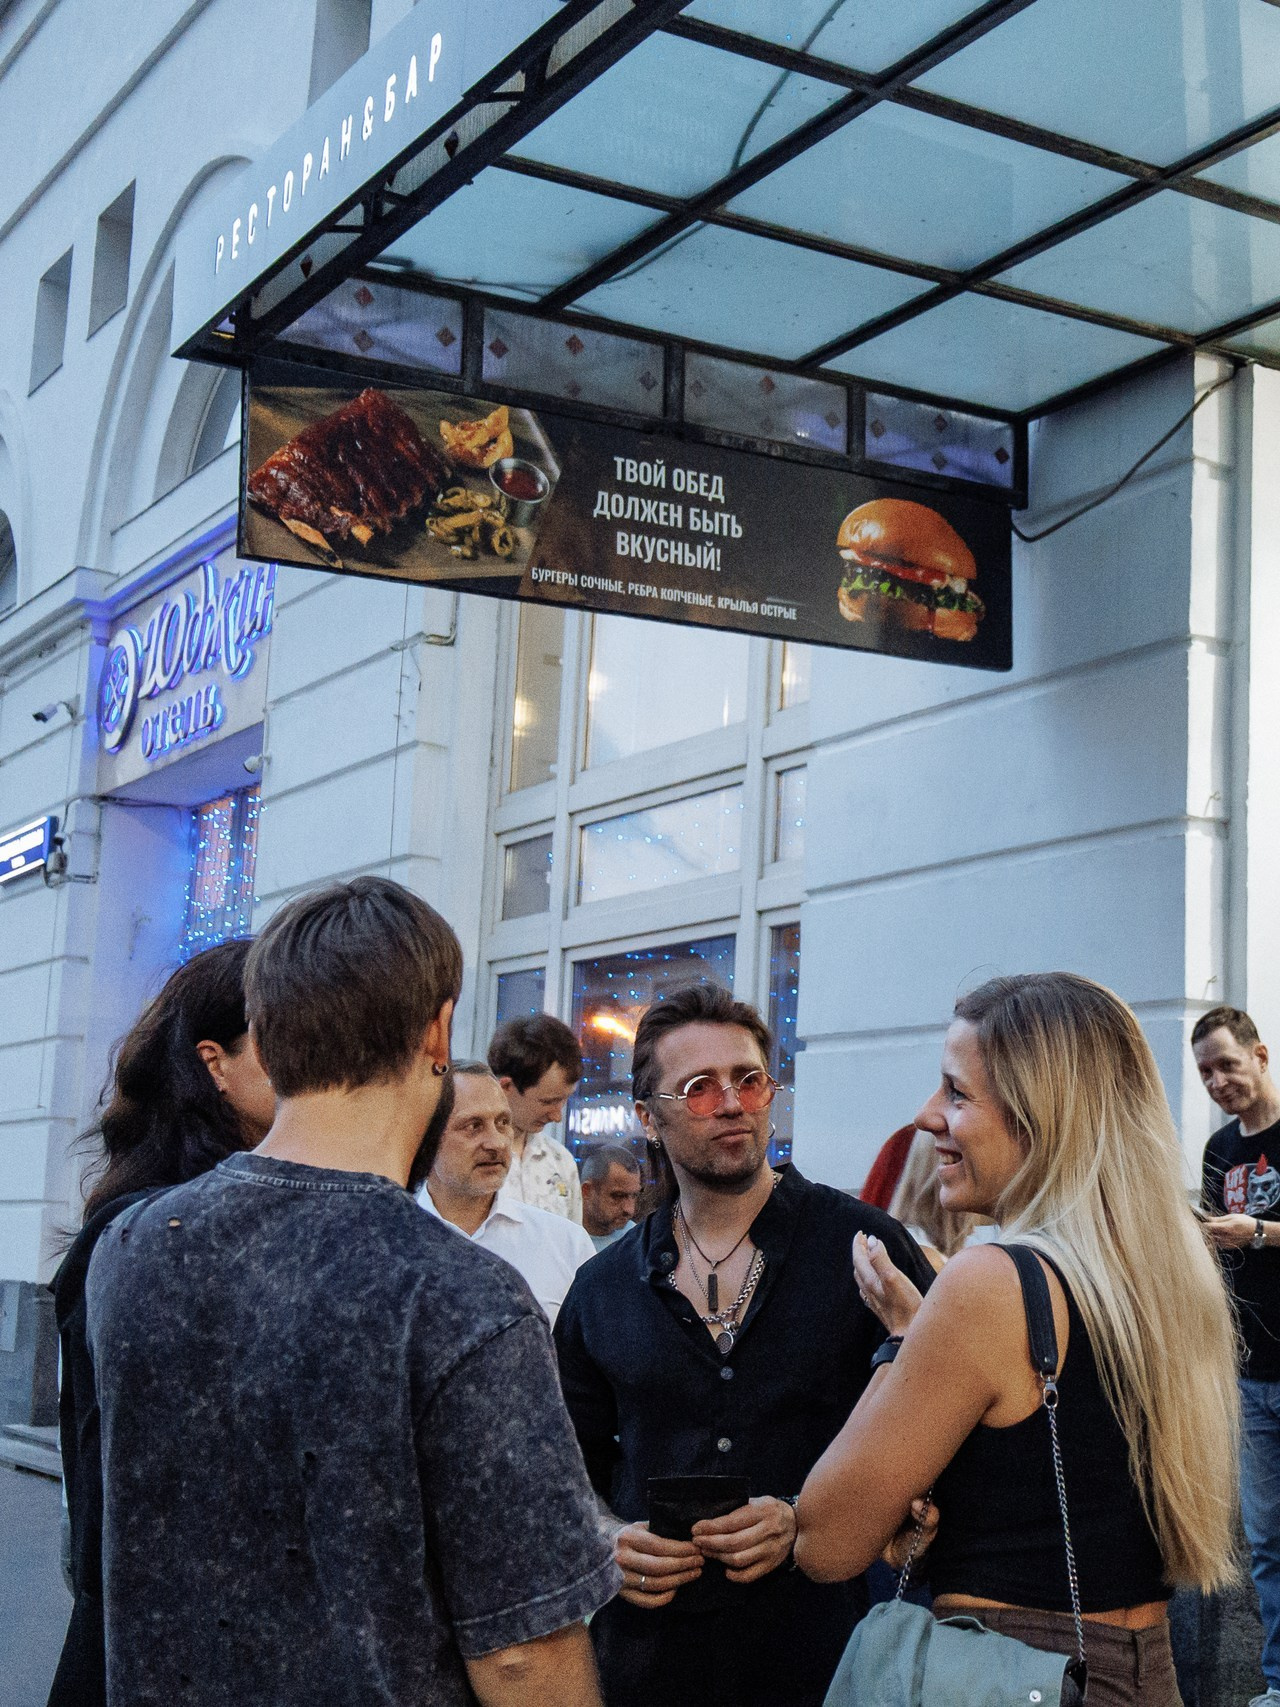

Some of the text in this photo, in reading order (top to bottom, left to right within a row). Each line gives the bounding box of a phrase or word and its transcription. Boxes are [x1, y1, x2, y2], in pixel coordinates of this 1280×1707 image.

[613, 456, 725, 503] ТВОЙ ОБЕД
[593, 490, 743, 539] ДОЛЖЕН БЫТЬ
[616, 531, 722, 572] ВКУСНЫЙ!
[531, 567, 797, 621] БУРГЕРЫ СОЧНЫЕ, РЕБРА КОПЧЕНЫЕ, КРЫЛЬЯ ОСТРЫЕ
